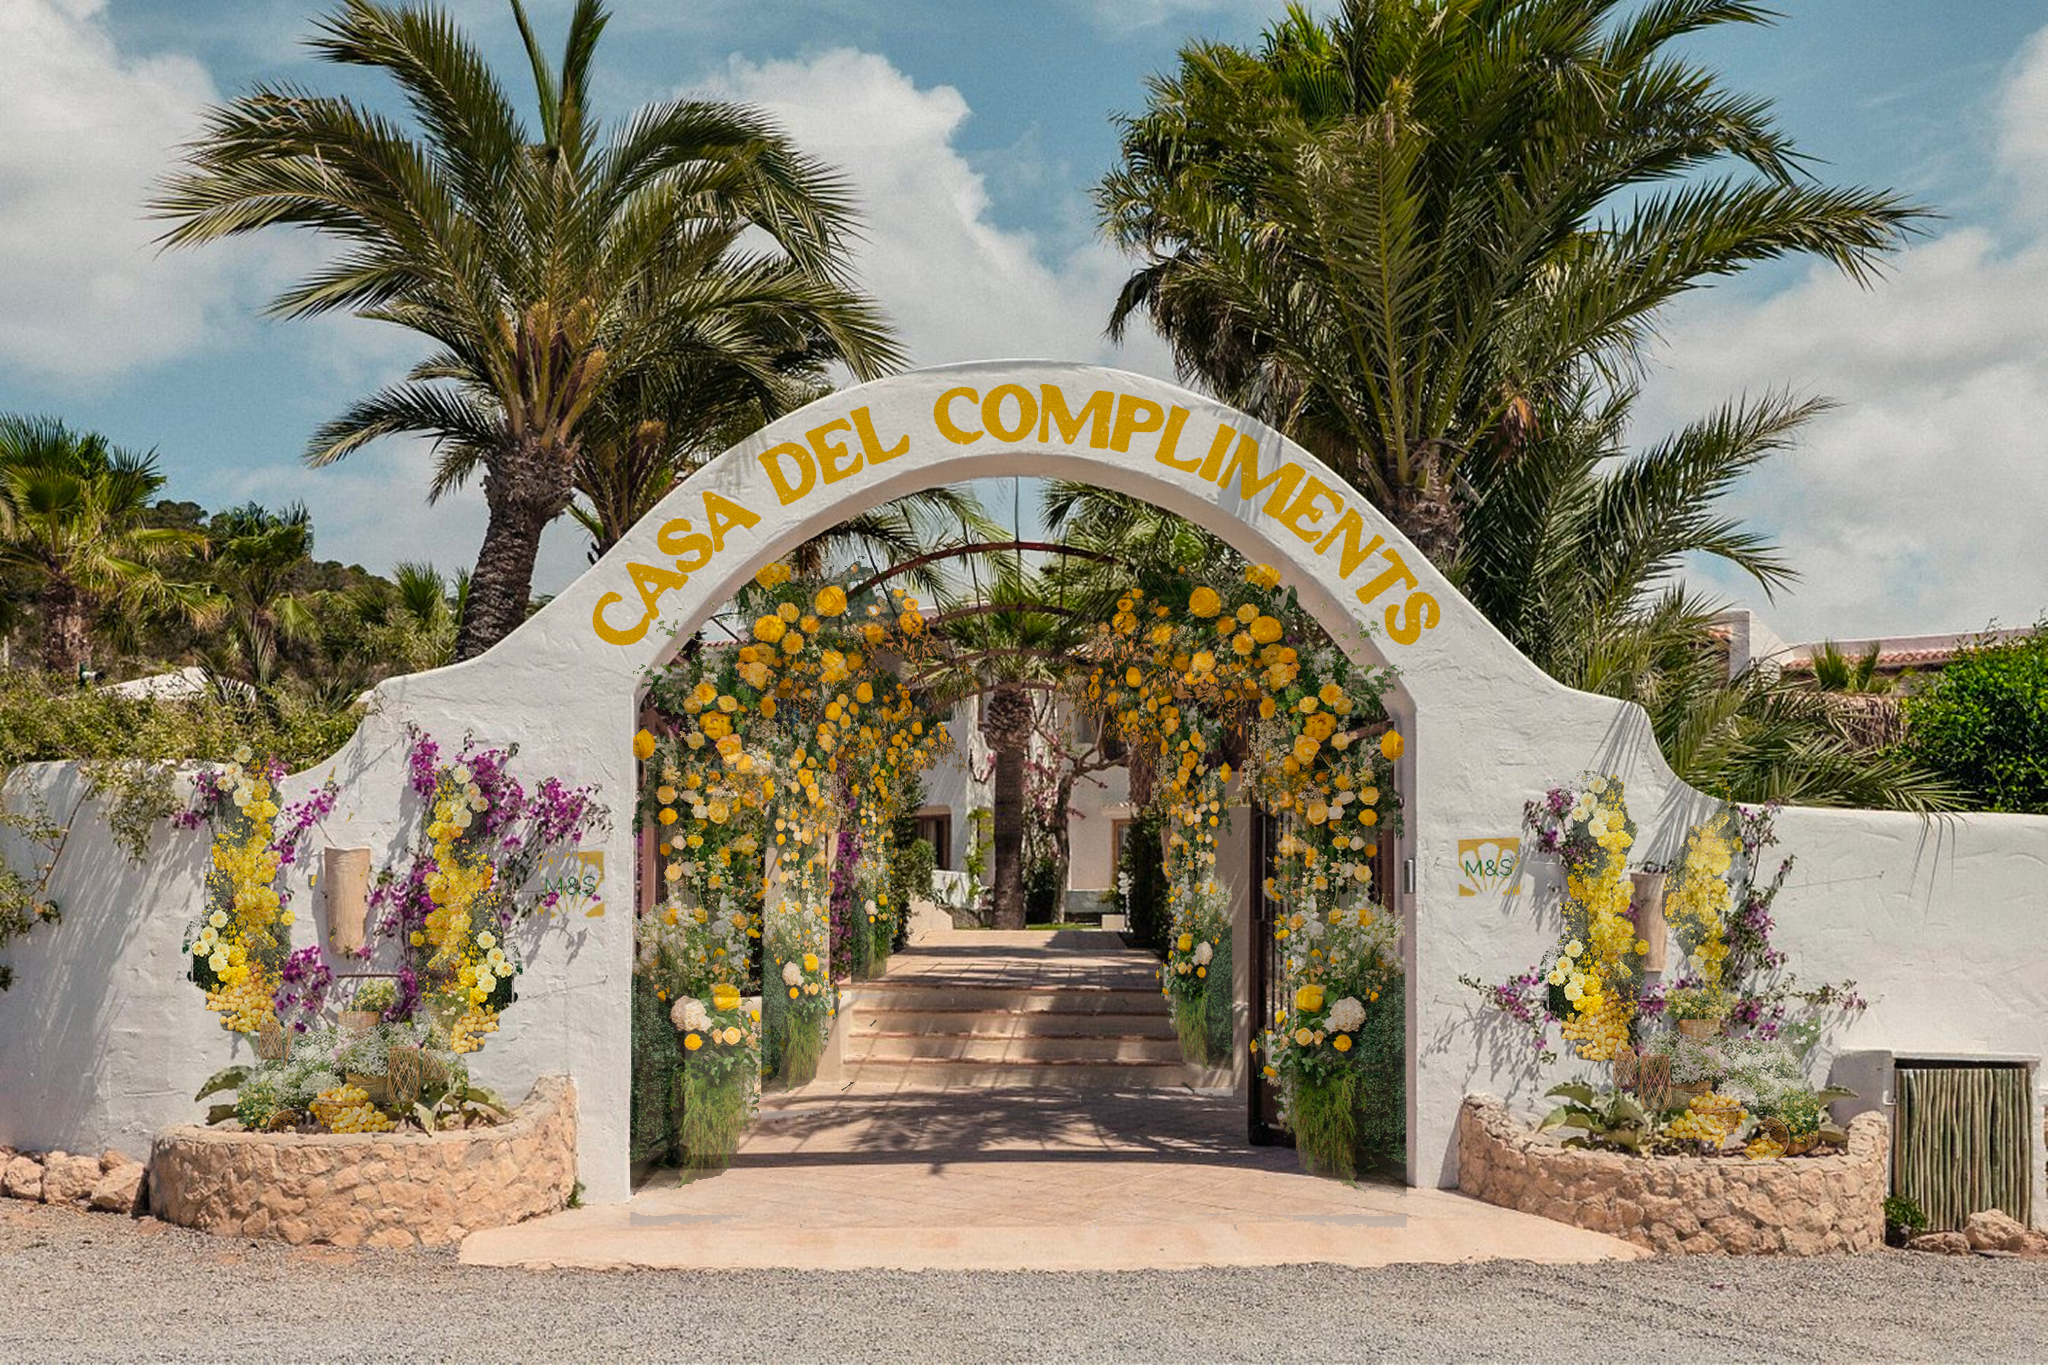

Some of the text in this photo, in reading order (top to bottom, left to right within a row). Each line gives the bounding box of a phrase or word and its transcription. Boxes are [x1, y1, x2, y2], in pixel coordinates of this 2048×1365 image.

[592, 383, 1441, 646] CASA DEL COMPLIMENTS
[1465, 858, 1513, 877] M&S
[544, 875, 596, 896] M&S
